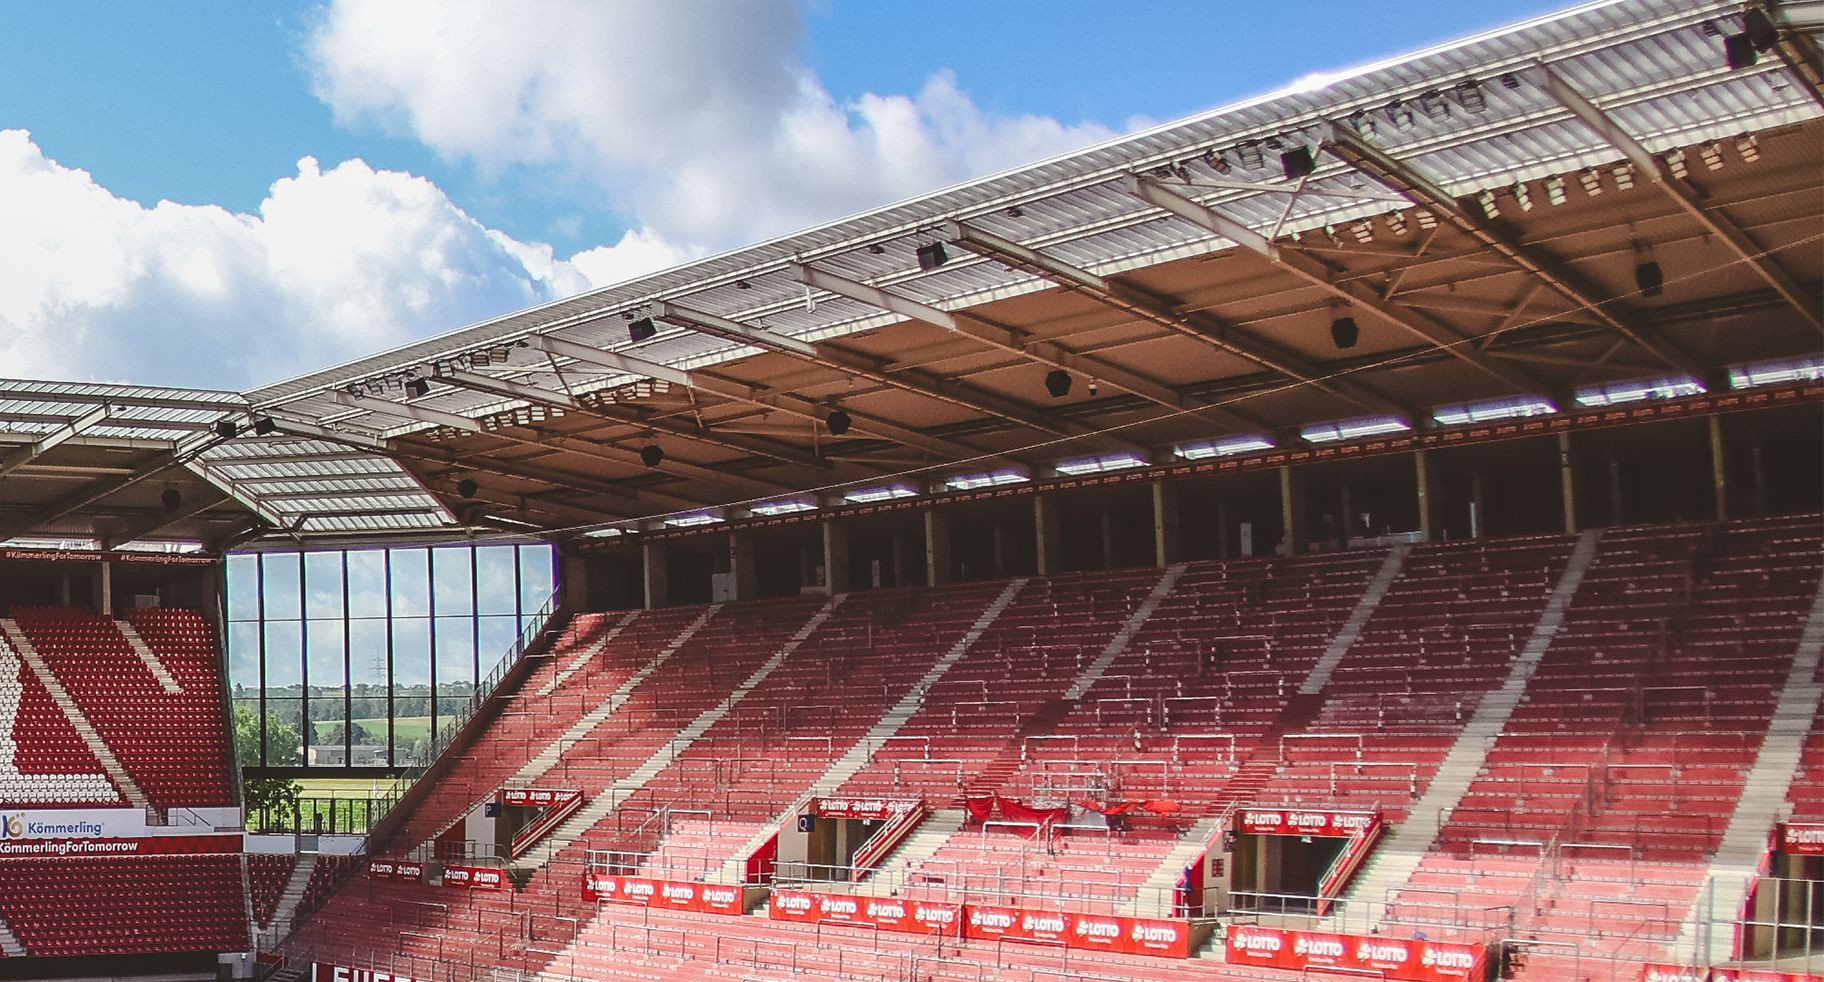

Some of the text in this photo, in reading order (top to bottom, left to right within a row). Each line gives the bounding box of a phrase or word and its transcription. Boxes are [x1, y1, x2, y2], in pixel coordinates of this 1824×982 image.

[861, 801, 882, 811] LOTTO
[798, 817, 808, 832] Q
[1254, 814, 1281, 825] LOTTO
[1299, 814, 1326, 826] LOTTO
[28, 821, 102, 836] Kömmerling
[632, 884, 654, 896] LOTTO
[671, 887, 694, 899] LOTTO
[711, 891, 732, 903] LOTTO
[786, 897, 811, 910] LOTTO
[831, 901, 857, 913] LOTTO
[878, 905, 902, 918] LOTTO
[925, 908, 953, 922] LOTTO
[981, 913, 1011, 927] LOTTO
[1034, 918, 1064, 932] LOTTO
[1089, 922, 1120, 937] LOTTO
[1145, 926, 1176, 942] LOTTO
[1247, 935, 1281, 951] LOTTO
[1308, 940, 1344, 956] LOTTO
[1371, 945, 1408, 962] LOTTO
[1436, 951, 1473, 968] LOTTO
